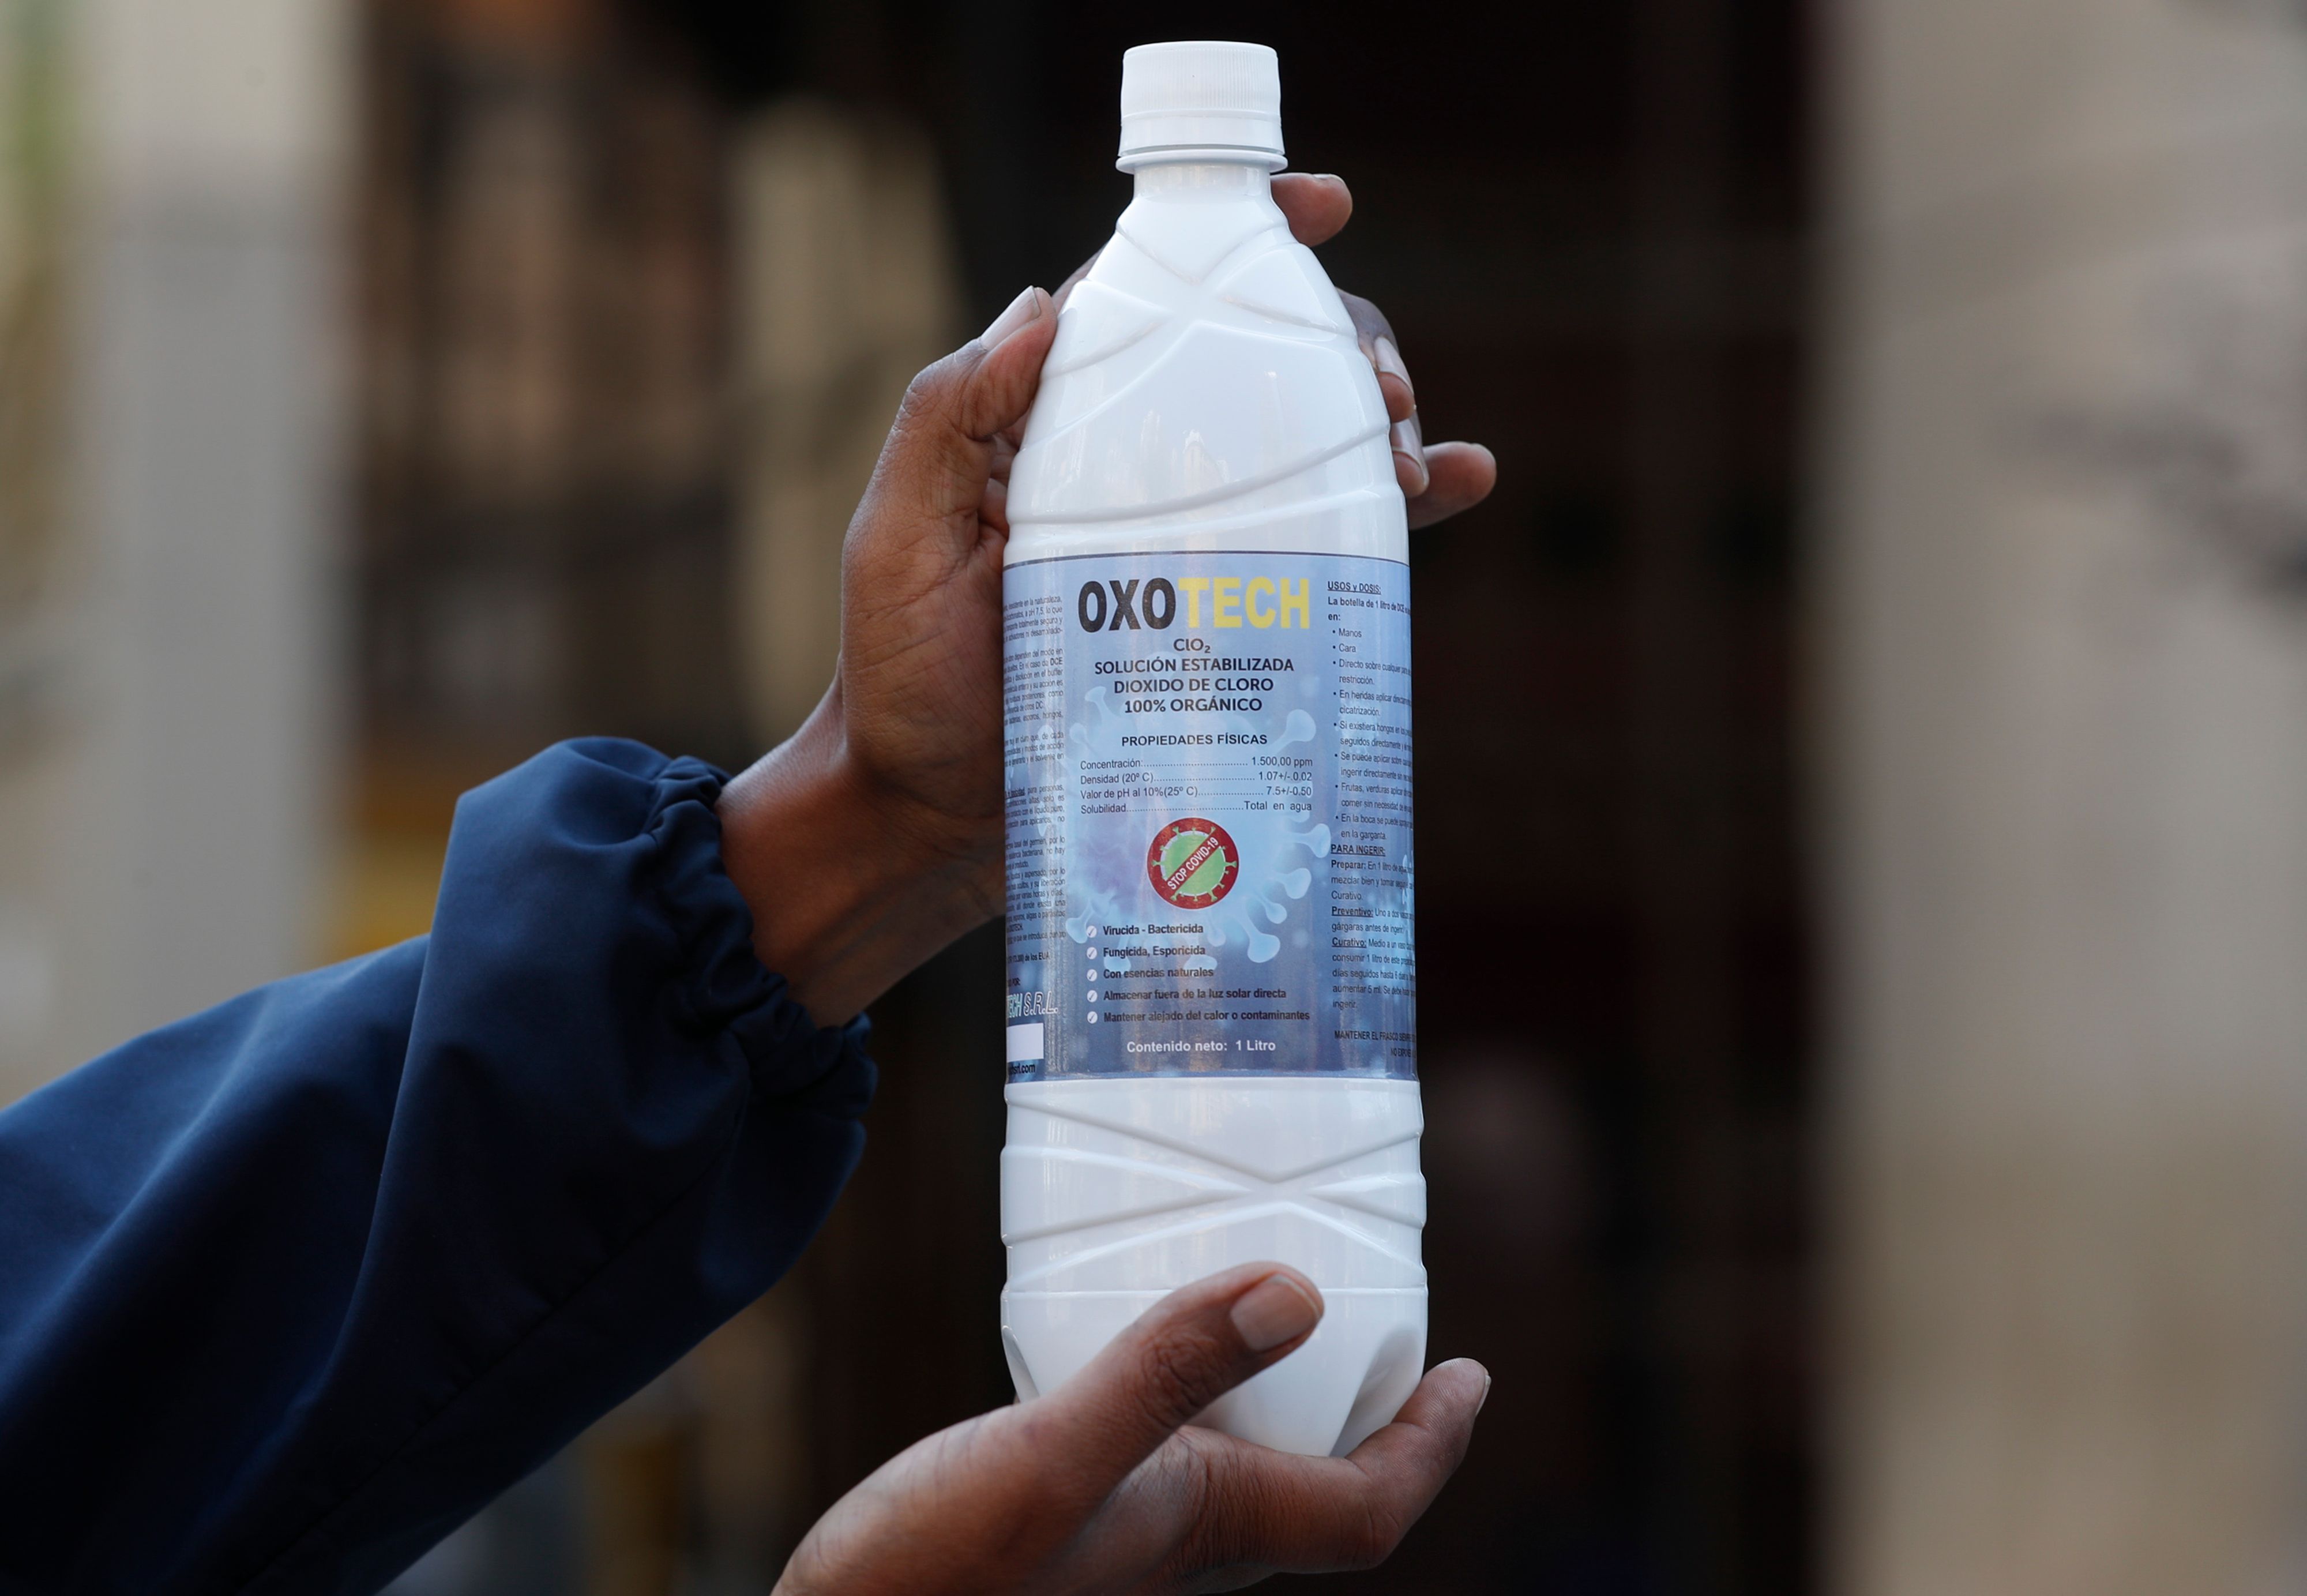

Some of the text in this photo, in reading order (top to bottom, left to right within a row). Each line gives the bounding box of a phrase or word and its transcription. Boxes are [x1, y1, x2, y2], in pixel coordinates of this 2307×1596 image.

[1328, 581, 1381, 595] USOS y DOSIS:
[1078, 577, 1310, 633] OXOTECH
[1328, 596, 1337, 605] La
[1340, 598, 1365, 606] botella
[1366, 599, 1374, 608] de
[1376, 600, 1378, 609] 1
[1339, 628, 1362, 637] Manos
[1339, 643, 1356, 652] Cara
[1050, 657, 1063, 666] DCE
[1095, 656, 1294, 674] SOLUCIÓN ESTABILIZADA
[1339, 659, 1364, 669] Directo
[1365, 661, 1381, 670] sobre
[1114, 678, 1273, 694] DIOXIDO DE CLORO
[1339, 675, 1375, 685] restricción.
[1340, 690, 1350, 699] En
[1351, 691, 1374, 700] heridas
[1376, 693, 1392, 703] aplicar
[1125, 695, 1262, 713] 100% ORGÁNICO
[1340, 705, 1381, 716] cicatrización.
[1340, 720, 1347, 729] Si
[1349, 722, 1376, 731] existiera
[1377, 723, 1394, 734] hongos
[1122, 732, 1267, 746] PROPIEDADES FÍSICAS
[1340, 737, 1370, 747] seguidos
[1080, 756, 1313, 770] Concentración: 1.500,00 ppm
[1341, 752, 1350, 761] Se
[1352, 753, 1372, 763] puede
[1373, 754, 1391, 764] aplicar
[1080, 774, 1119, 785] Densidad
[1142, 772, 1154, 783] C)
[1341, 767, 1396, 779] ingerir directamente
[1080, 790, 1102, 799] Valor
[1104, 789, 1114, 798] de
[1117, 788, 1130, 799] pH
[1133, 788, 1140, 797] al
[1186, 786, 1198, 798] C)
[1266, 786, 1312, 796] 7.5+/-0.50
[1341, 783, 1365, 793] Frutas,
[1366, 785, 1389, 795] verduras
[1080, 803, 1126, 814] Solubilidad
[1244, 801, 1267, 810] Total
[1290, 803, 1312, 813] agua
[1374, 801, 1399, 810] necesidad
[1342, 813, 1351, 823] En
[1352, 814, 1359, 823] la
[1361, 814, 1376, 824] boca
[1352, 829, 1359, 838] la
[1331, 844, 1386, 857] PARA INGERIR:
[1167, 837, 1219, 890] STOP COVID-19
[1331, 859, 1366, 870] Preparar:
[1367, 861, 1376, 870] En
[1331, 876, 1359, 885] mezclar
[1361, 876, 1375, 885] bien
[1376, 878, 1380, 888] y
[1332, 906, 1373, 918] Preventivo:
[1375, 908, 1387, 917] Uno
[1103, 925, 1140, 936] Virucida
[1148, 924, 1204, 934] Bactericida
[1332, 922, 1363, 933] gárgaras
[1365, 923, 1381, 932] antes
[1382, 923, 1389, 933] de
[1332, 937, 1367, 948] Curativo:
[1368, 938, 1387, 948] Medio
[1103, 945, 1205, 959] Fungicida, Esporicida
[1332, 954, 1365, 963] consumir
[1367, 954, 1370, 963] 1
[1384, 955, 1390, 964] de
[1103, 967, 1214, 979] Con esencias naturales
[1332, 968, 1393, 979] días seguidos hasta
[1104, 988, 1286, 1000] Almacenar fuera de la luz solar directa
[1333, 985, 1366, 993] aumentar
[1383, 985, 1391, 994] Se
[1104, 1012, 1145, 1022] Mantener
[1148, 1011, 1183, 1023] alejado
[1186, 1011, 1201, 1020] del
[1204, 1010, 1229, 1020] calor
[1241, 1010, 1310, 1020] contaminantes
[1335, 1030, 1398, 1041] MANTENER EL FRASCO
[1127, 1039, 1276, 1053] Contenido neto: 1 Litro
